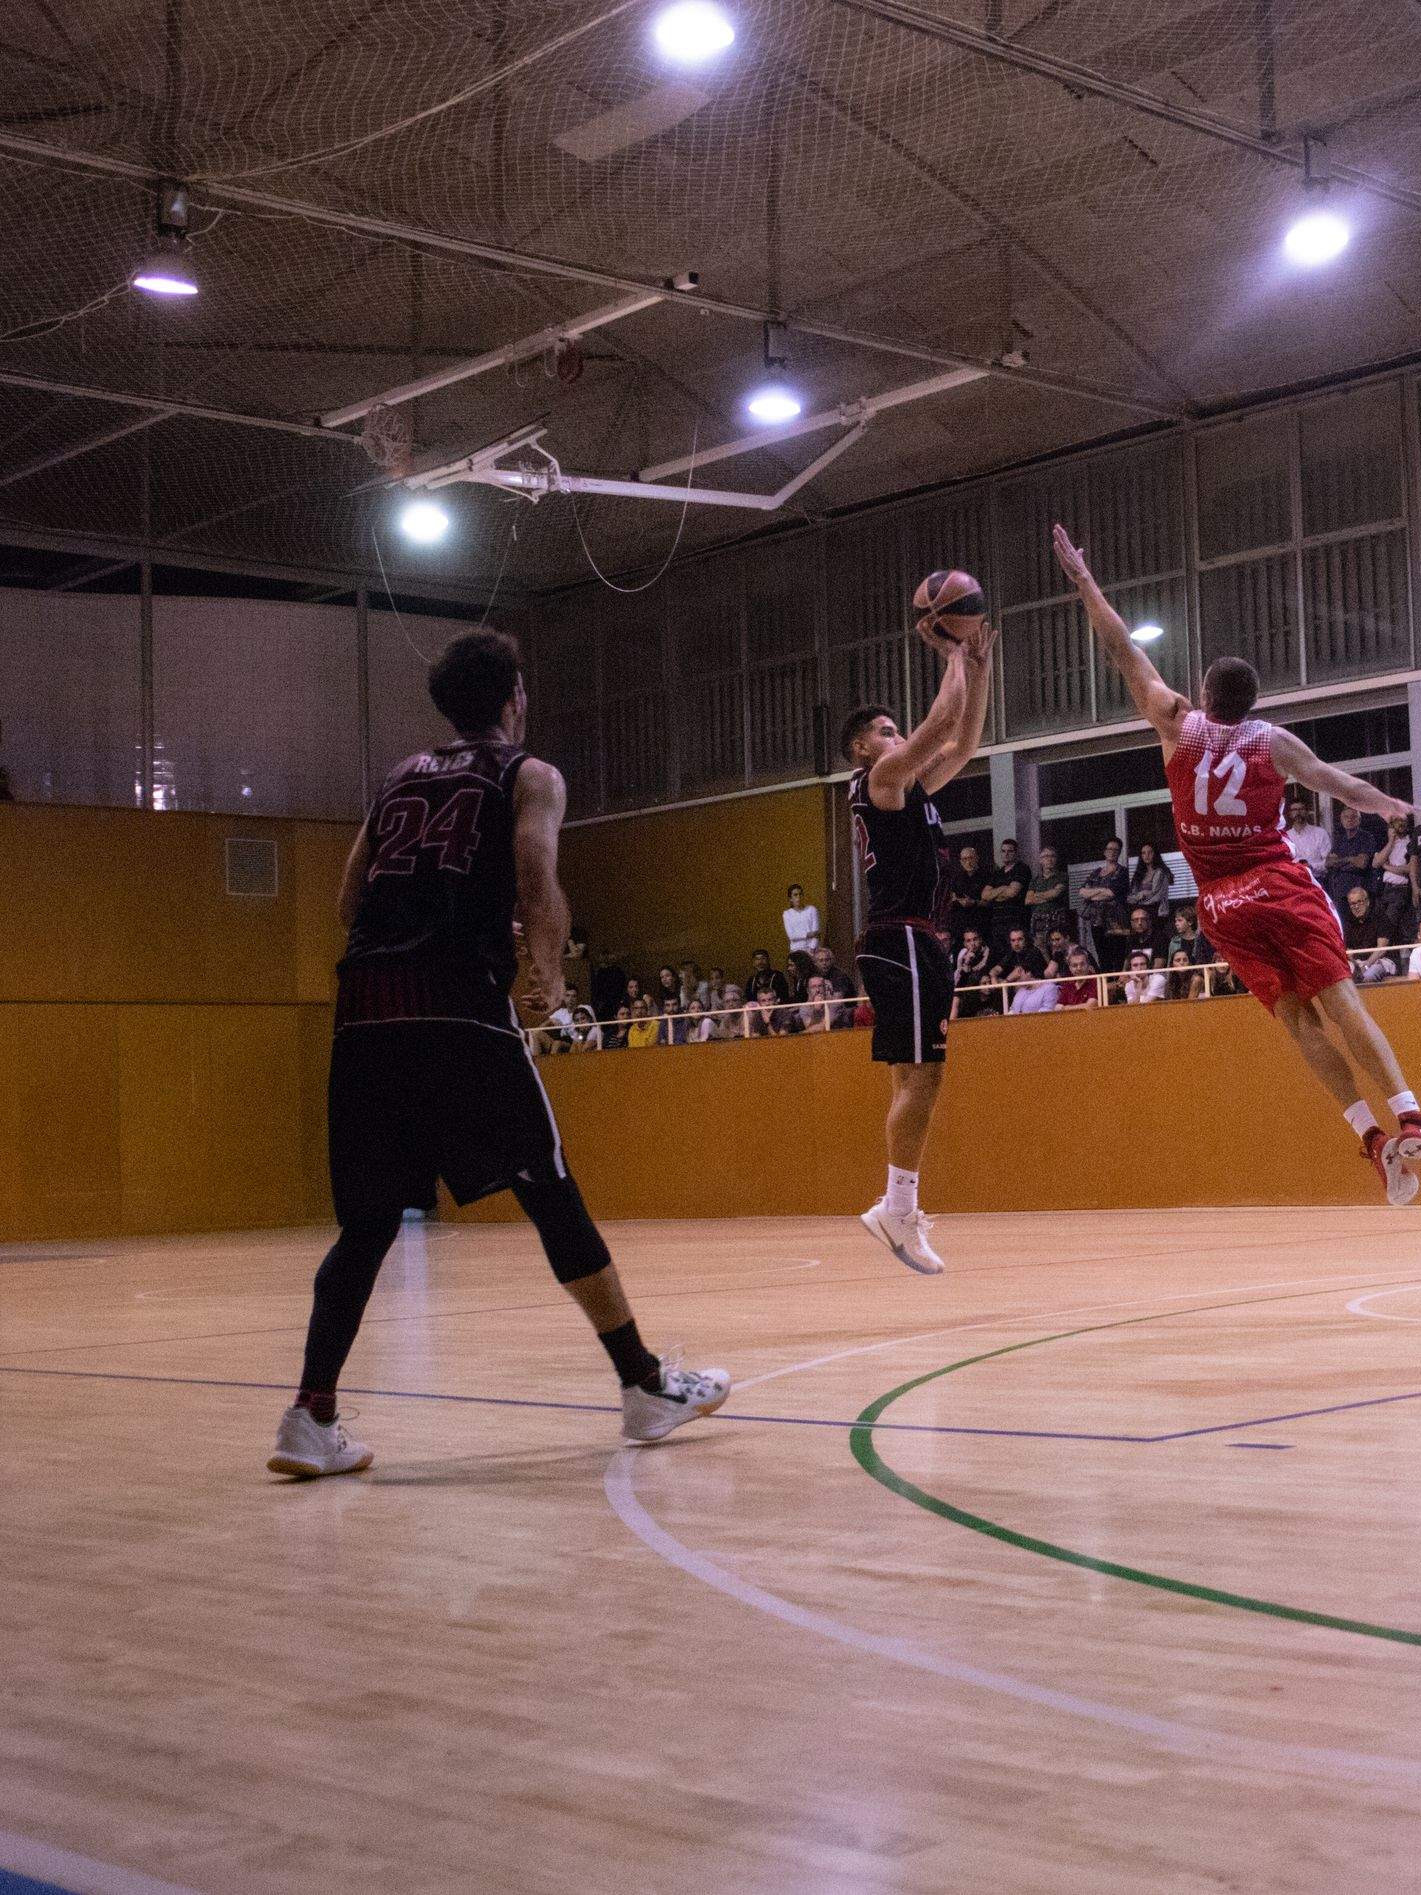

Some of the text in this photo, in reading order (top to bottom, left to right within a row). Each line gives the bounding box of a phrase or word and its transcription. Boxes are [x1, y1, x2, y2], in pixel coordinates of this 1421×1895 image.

[1194, 750, 1247, 816] 12
[368, 789, 484, 881] 24
[1181, 822, 1204, 836] C.B.
